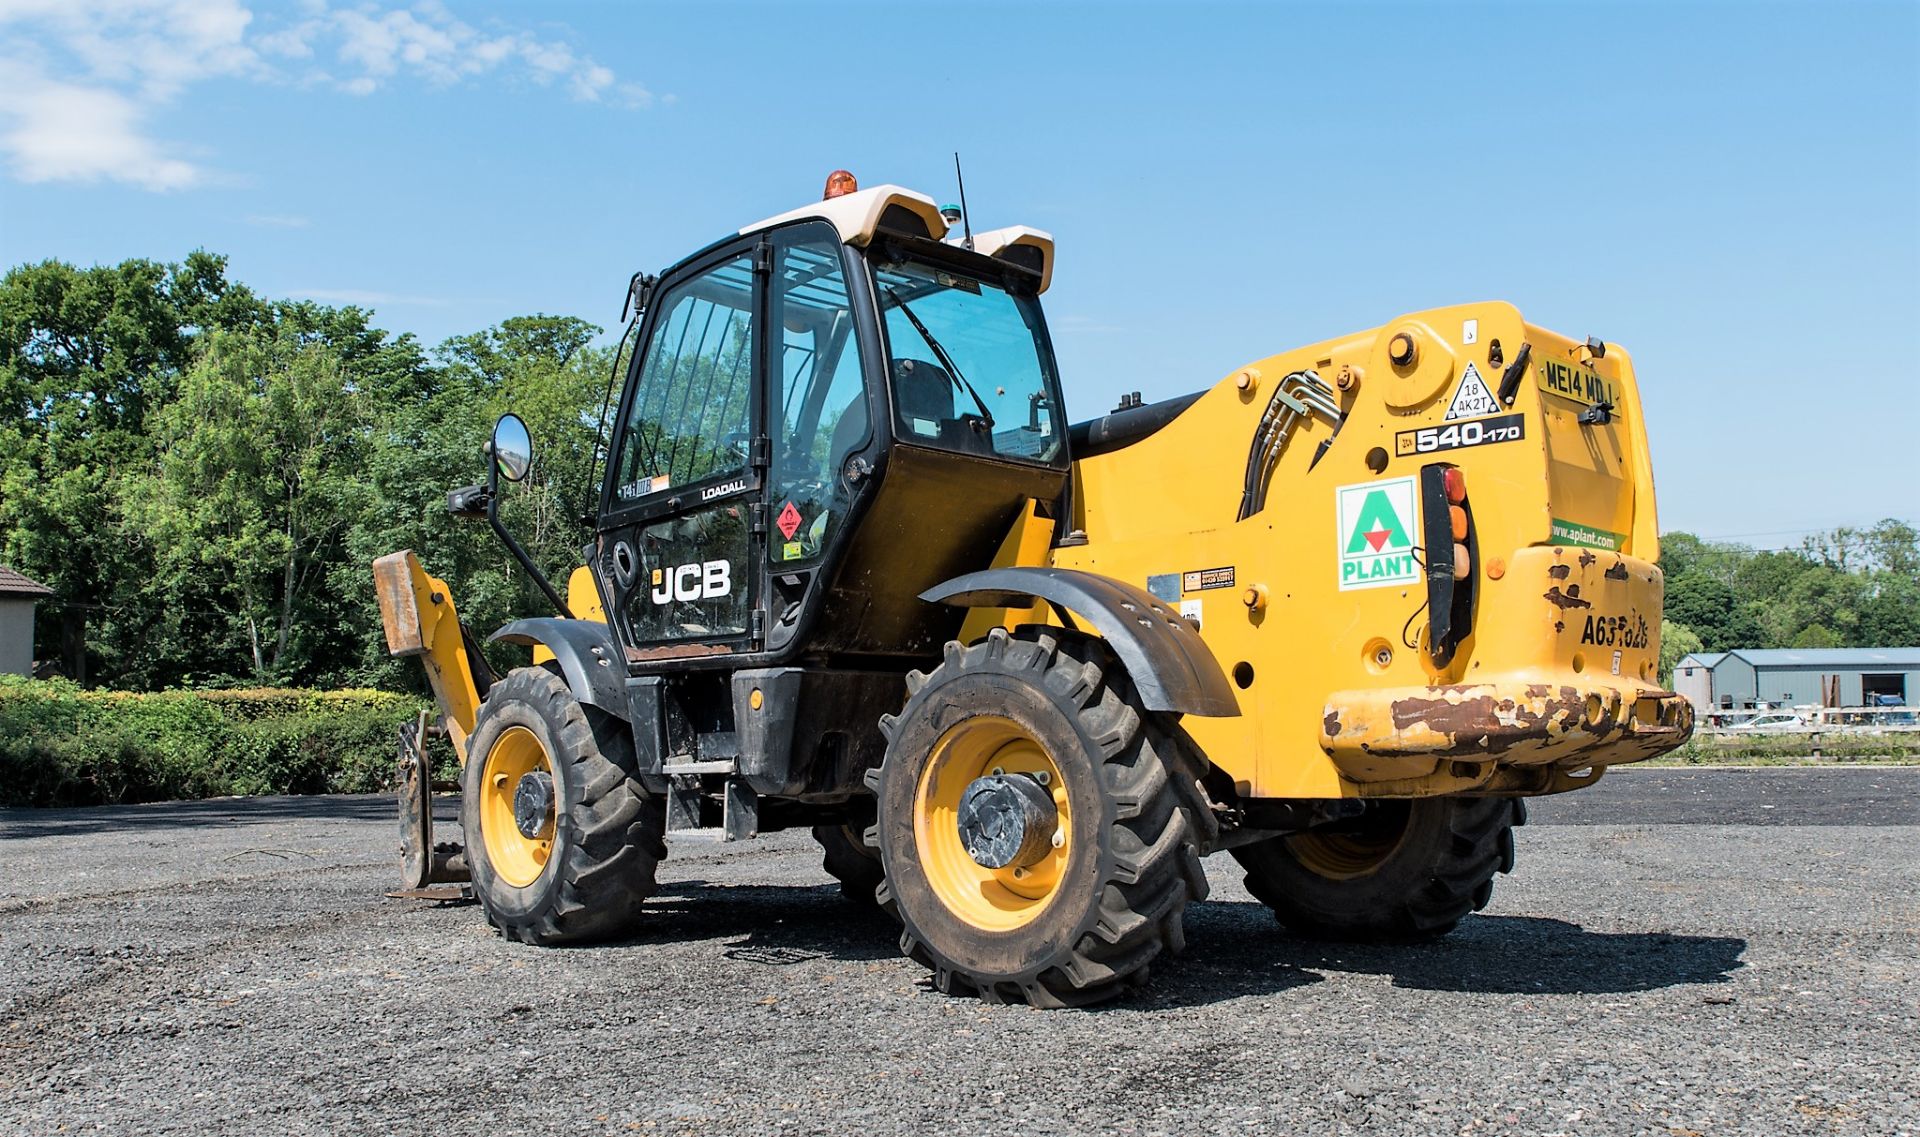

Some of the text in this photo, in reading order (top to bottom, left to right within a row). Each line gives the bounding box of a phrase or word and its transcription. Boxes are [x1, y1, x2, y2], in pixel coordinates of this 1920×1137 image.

[1464, 384, 1479, 397] 18
[1546, 361, 1613, 405] ME14 MDJ
[1458, 397, 1488, 412] AK2T
[1417, 422, 1520, 452] 540-170
[702, 480, 747, 501] LOADALL
[1346, 489, 1412, 554] A
[652, 559, 731, 605] JCB
[1343, 555, 1415, 581] PLANT
